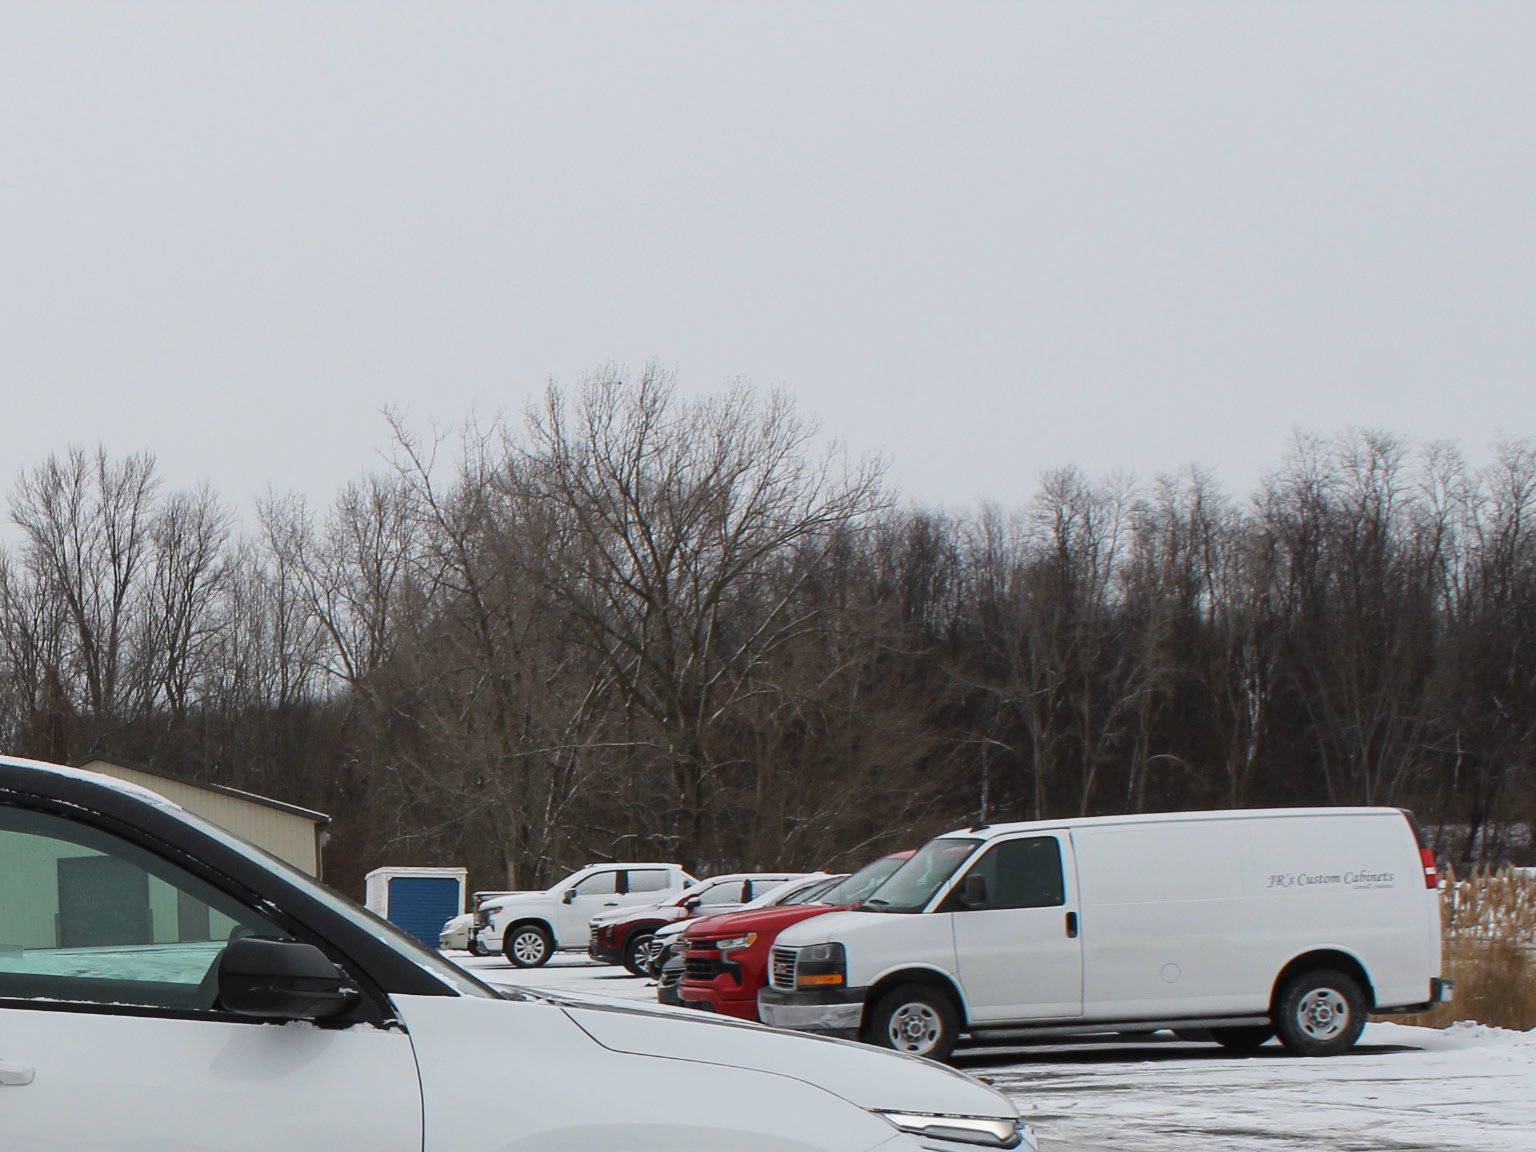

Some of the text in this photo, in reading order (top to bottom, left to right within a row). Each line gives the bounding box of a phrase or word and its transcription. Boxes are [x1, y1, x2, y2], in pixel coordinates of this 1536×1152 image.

[1266, 873, 1295, 888] JR's
[1297, 873, 1340, 886] Custom
[1344, 870, 1394, 884] Cabinets
